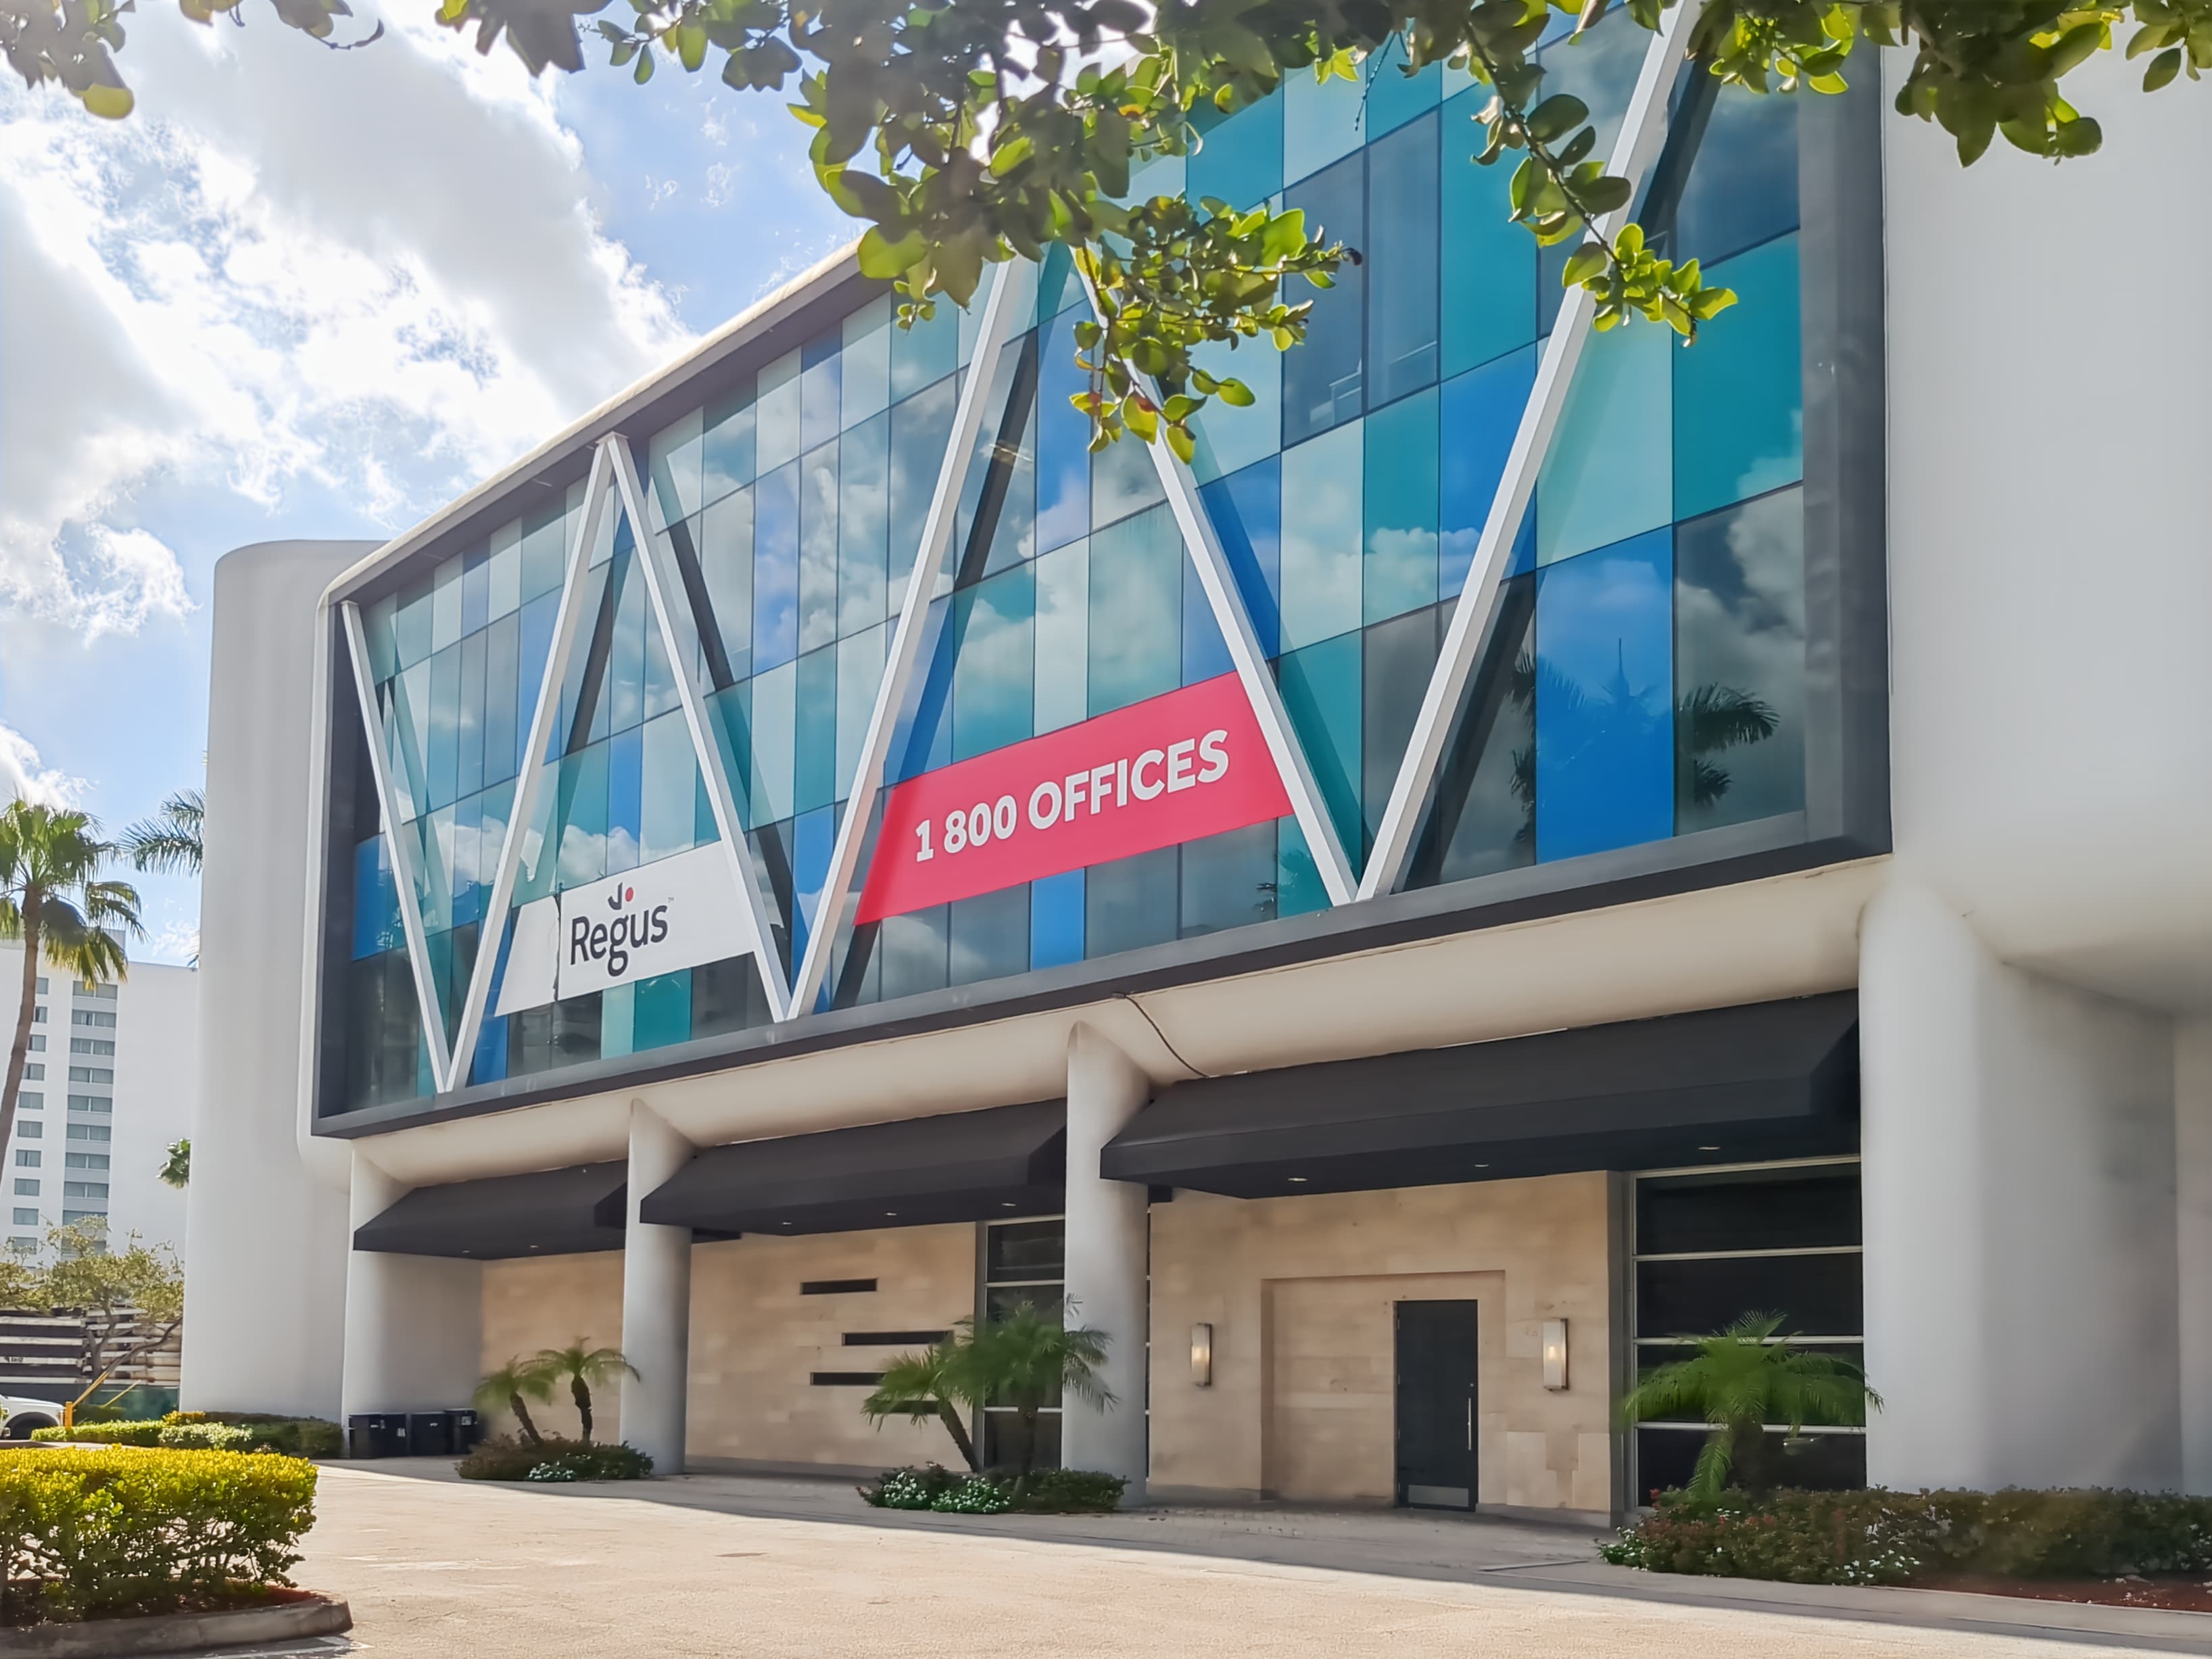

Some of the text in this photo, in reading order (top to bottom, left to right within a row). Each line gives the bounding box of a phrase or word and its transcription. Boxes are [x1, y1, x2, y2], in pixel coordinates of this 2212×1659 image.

[915, 729, 1229, 862] 1 800 OFFICES
[571, 905, 668, 977] Regus
